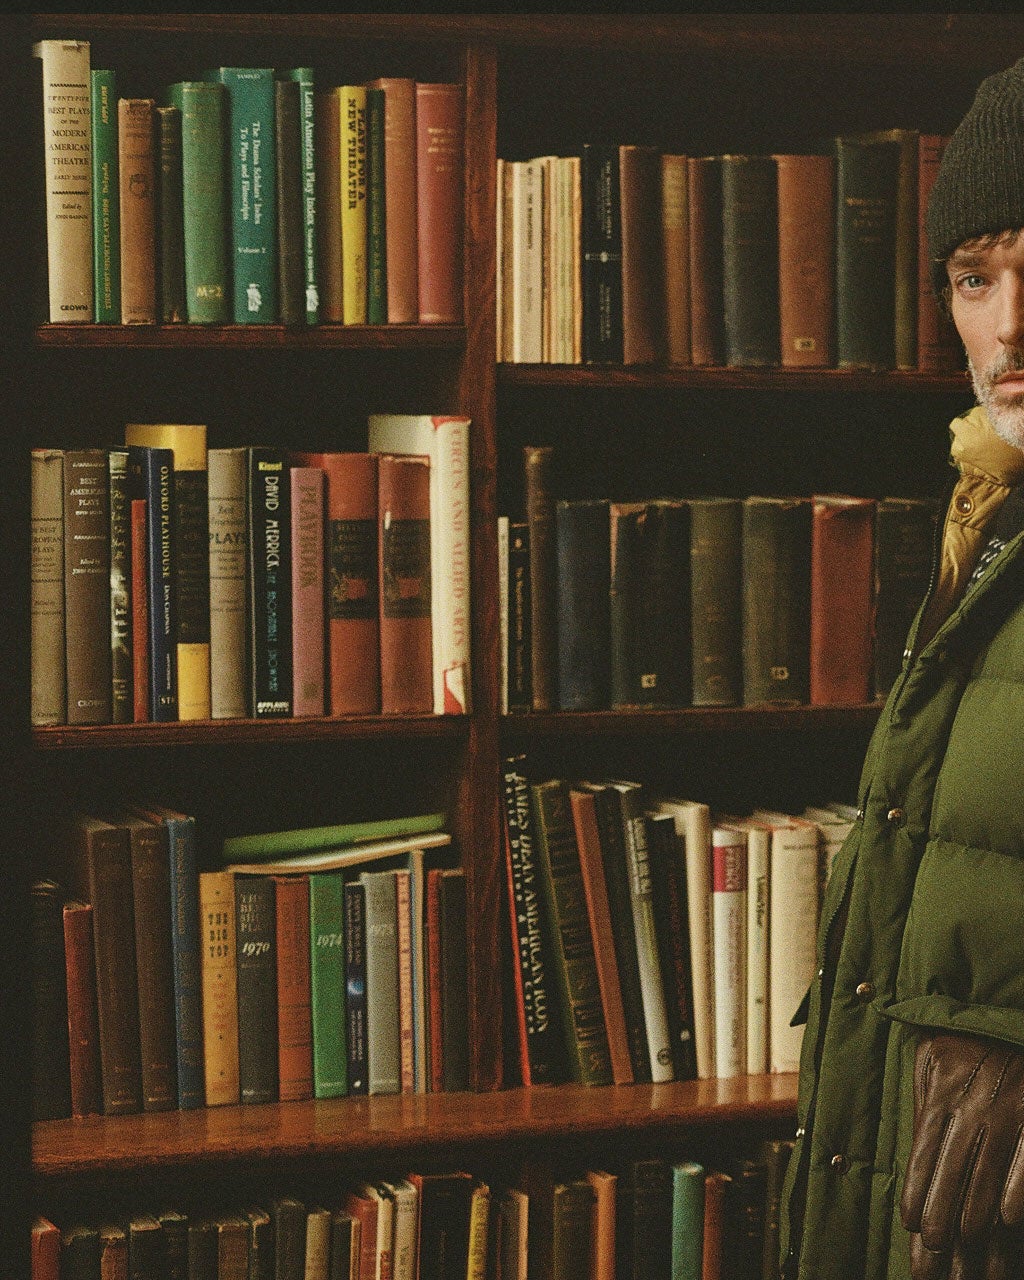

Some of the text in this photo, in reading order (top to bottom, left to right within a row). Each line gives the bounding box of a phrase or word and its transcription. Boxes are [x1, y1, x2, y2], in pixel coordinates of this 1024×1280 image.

[48, 107, 92, 115] BEST PLAYS
[304, 91, 314, 117] Latin
[52, 129, 87, 138] MODERN
[252, 121, 261, 137] The
[48, 143, 91, 151] AMERICAN
[252, 139, 261, 165] Drama
[305, 123, 315, 170] American
[348, 98, 357, 210] NEW THEATER
[358, 109, 367, 201] PLAYS FOR A
[52, 157, 91, 165] THEATRE
[239, 128, 250, 220] To Plays and Filmscripts
[253, 168, 262, 201] Scholars'
[304, 172, 316, 193] Play
[307, 197, 316, 225] Index
[70, 488, 107, 496] AMERICAN
[160, 466, 169, 511] OXFORD
[264, 475, 279, 511] DAVID
[161, 514, 171, 579] PLAYHOUSE
[513, 771, 530, 830] JAMES
[520, 834, 535, 884] DEAN
[209, 913, 228, 925] THE
[210, 929, 228, 942] BIG
[523, 889, 545, 986] AMERICAN
[209, 945, 229, 957] TOP
[242, 942, 271, 957] 1970
[533, 988, 549, 1033] ICON
